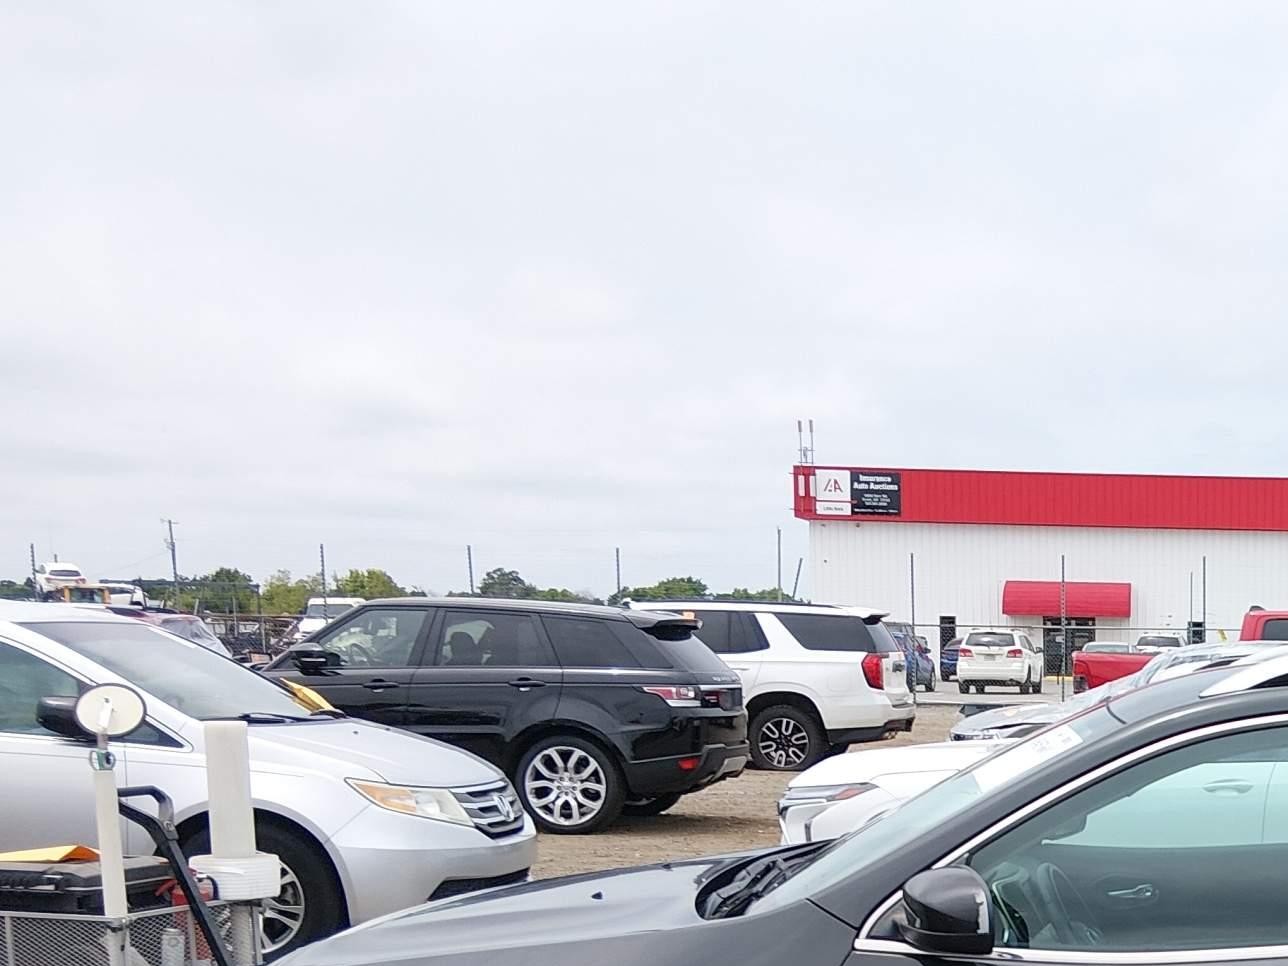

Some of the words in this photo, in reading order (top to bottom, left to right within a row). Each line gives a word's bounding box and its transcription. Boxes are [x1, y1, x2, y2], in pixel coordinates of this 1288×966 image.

[858, 474, 892, 483] Insurance
[853, 481, 869, 490] Auto
[869, 482, 899, 491] Auctions
